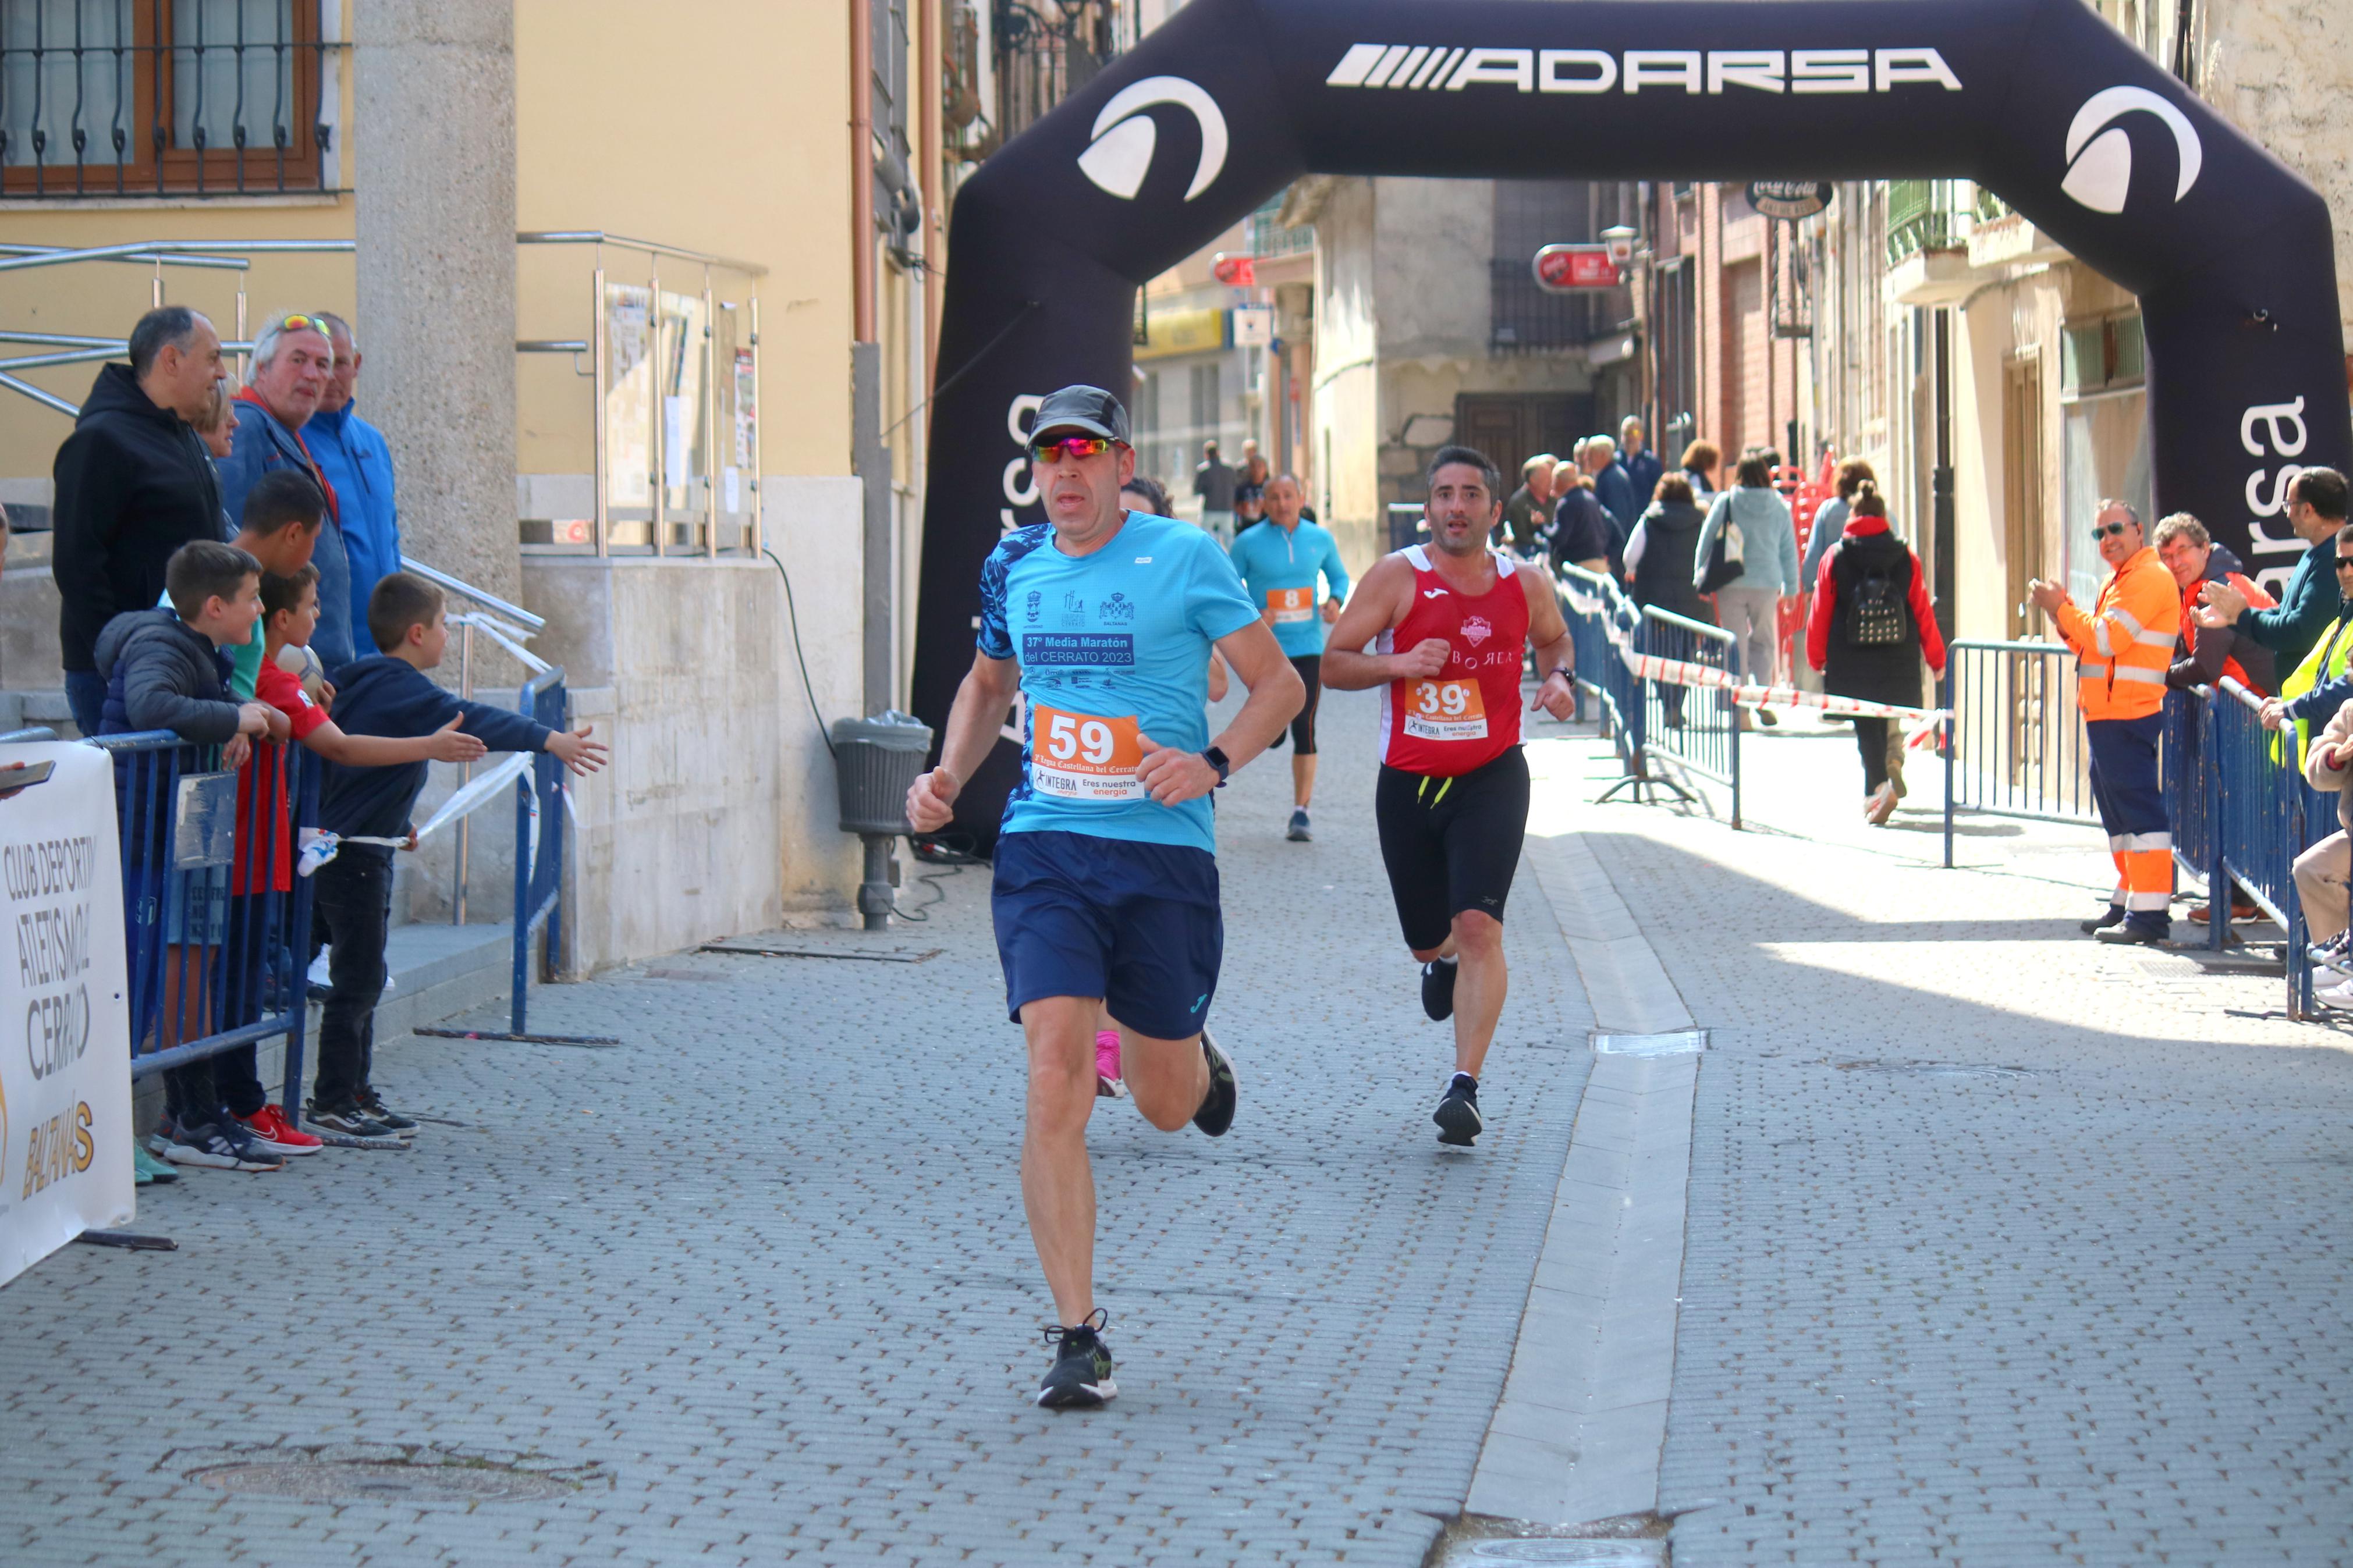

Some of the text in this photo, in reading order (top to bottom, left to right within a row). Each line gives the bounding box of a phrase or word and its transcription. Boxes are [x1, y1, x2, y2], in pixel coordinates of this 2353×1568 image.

[1445, 47, 1962, 94] ADARSA
[1284, 589, 1299, 608] 8
[1045, 637, 1078, 648] Media
[1081, 637, 1128, 648] Maratón
[1024, 652, 1132, 663] del CERRATO 2023
[1419, 682, 1466, 715] 39
[1048, 714, 1114, 765] 59
[1057, 760, 1094, 772] Castellana
[1096, 765, 1107, 773] del
[1045, 774, 1077, 791] INTEGRA
[1083, 779, 1099, 787] Eres
[3, 843, 38, 901] CLUB
